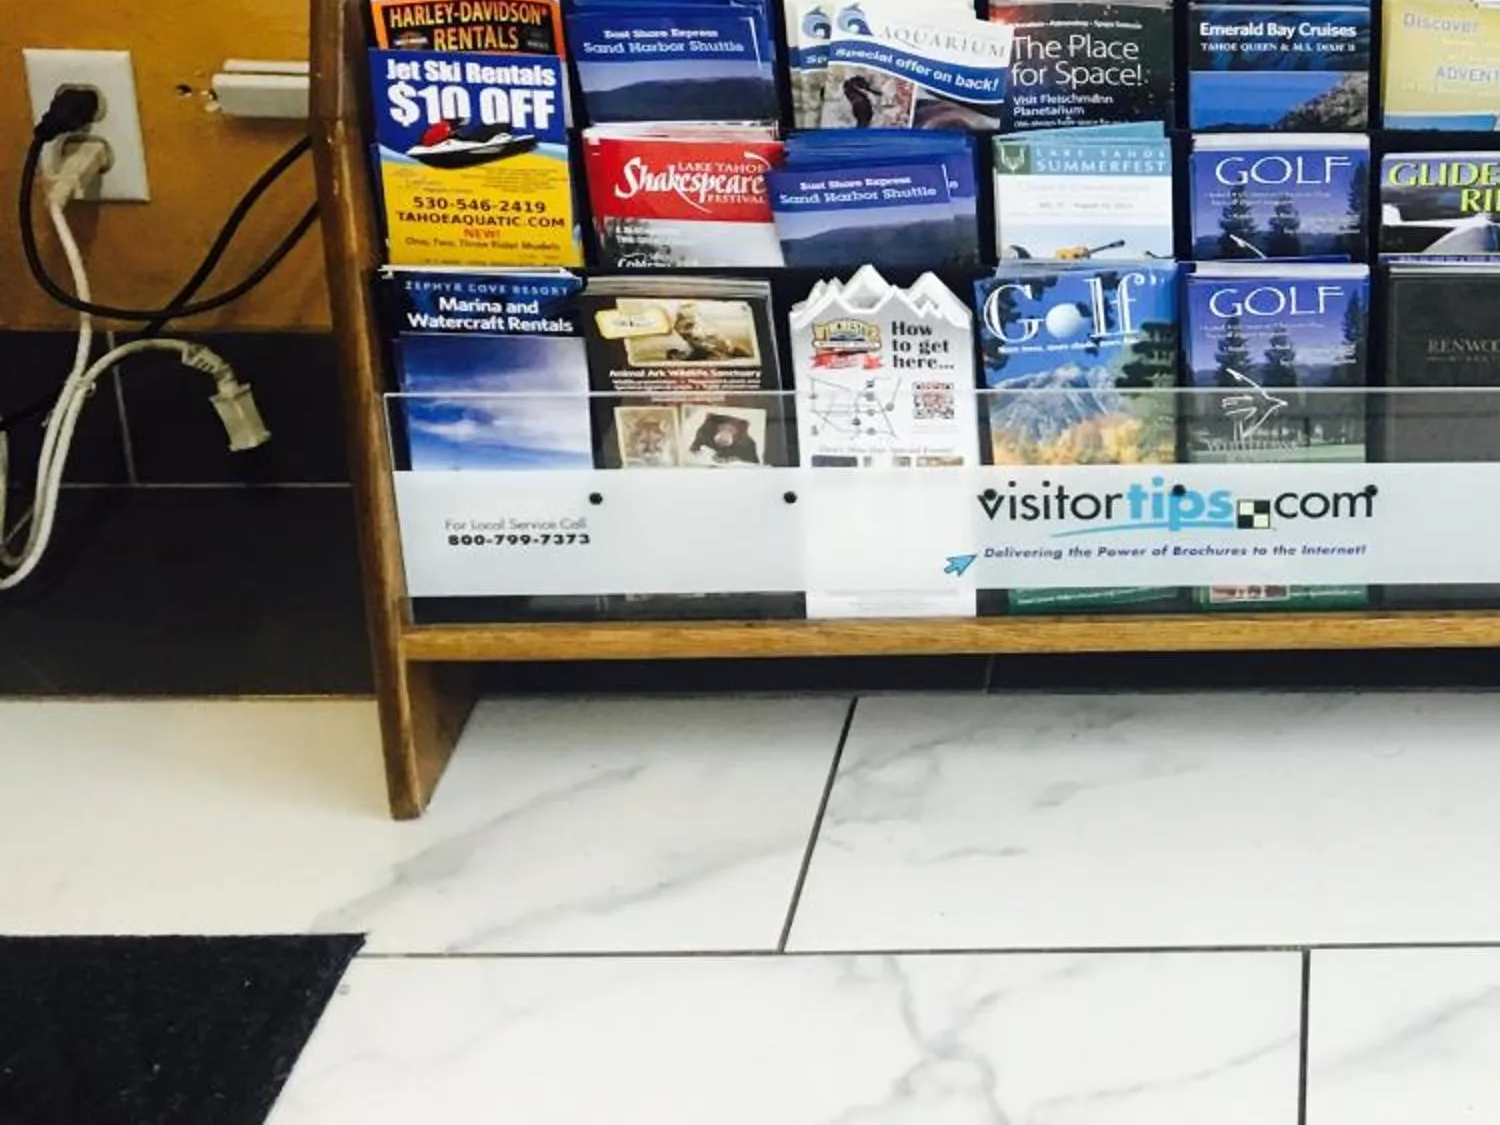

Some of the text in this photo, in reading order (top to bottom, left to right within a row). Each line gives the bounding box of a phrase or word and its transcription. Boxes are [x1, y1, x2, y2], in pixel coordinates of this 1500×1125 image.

[390, 1, 540, 28] HARLEY-DAVIDSON
[434, 26, 519, 51] RENTALS
[1200, 23, 1357, 39] Emerald Bay Cruises
[387, 59, 556, 86] Jet Ski Rentals
[388, 81, 555, 130] $10 OFF
[1036, 159, 1166, 173] SUMMERFEST
[1215, 156, 1351, 186] GOLF
[615, 157, 766, 203] Shakespeare
[413, 196, 546, 213] 530-546-2419
[397, 211, 566, 228] TAHOEAQUATIC.COM
[439, 297, 539, 315] Marina and
[1209, 286, 1344, 317] GOLF
[407, 315, 574, 333] Watercraft Rentals
[891, 321, 932, 337] How
[892, 339, 915, 353] to
[919, 339, 949, 356] get
[977, 476, 1378, 533] visitortips.com
[446, 518, 587, 531] For Local Service Call
[447, 534, 590, 546] 800-799-7373
[984, 545, 1365, 560] Delivering the Power of Brochures to the Internet!
